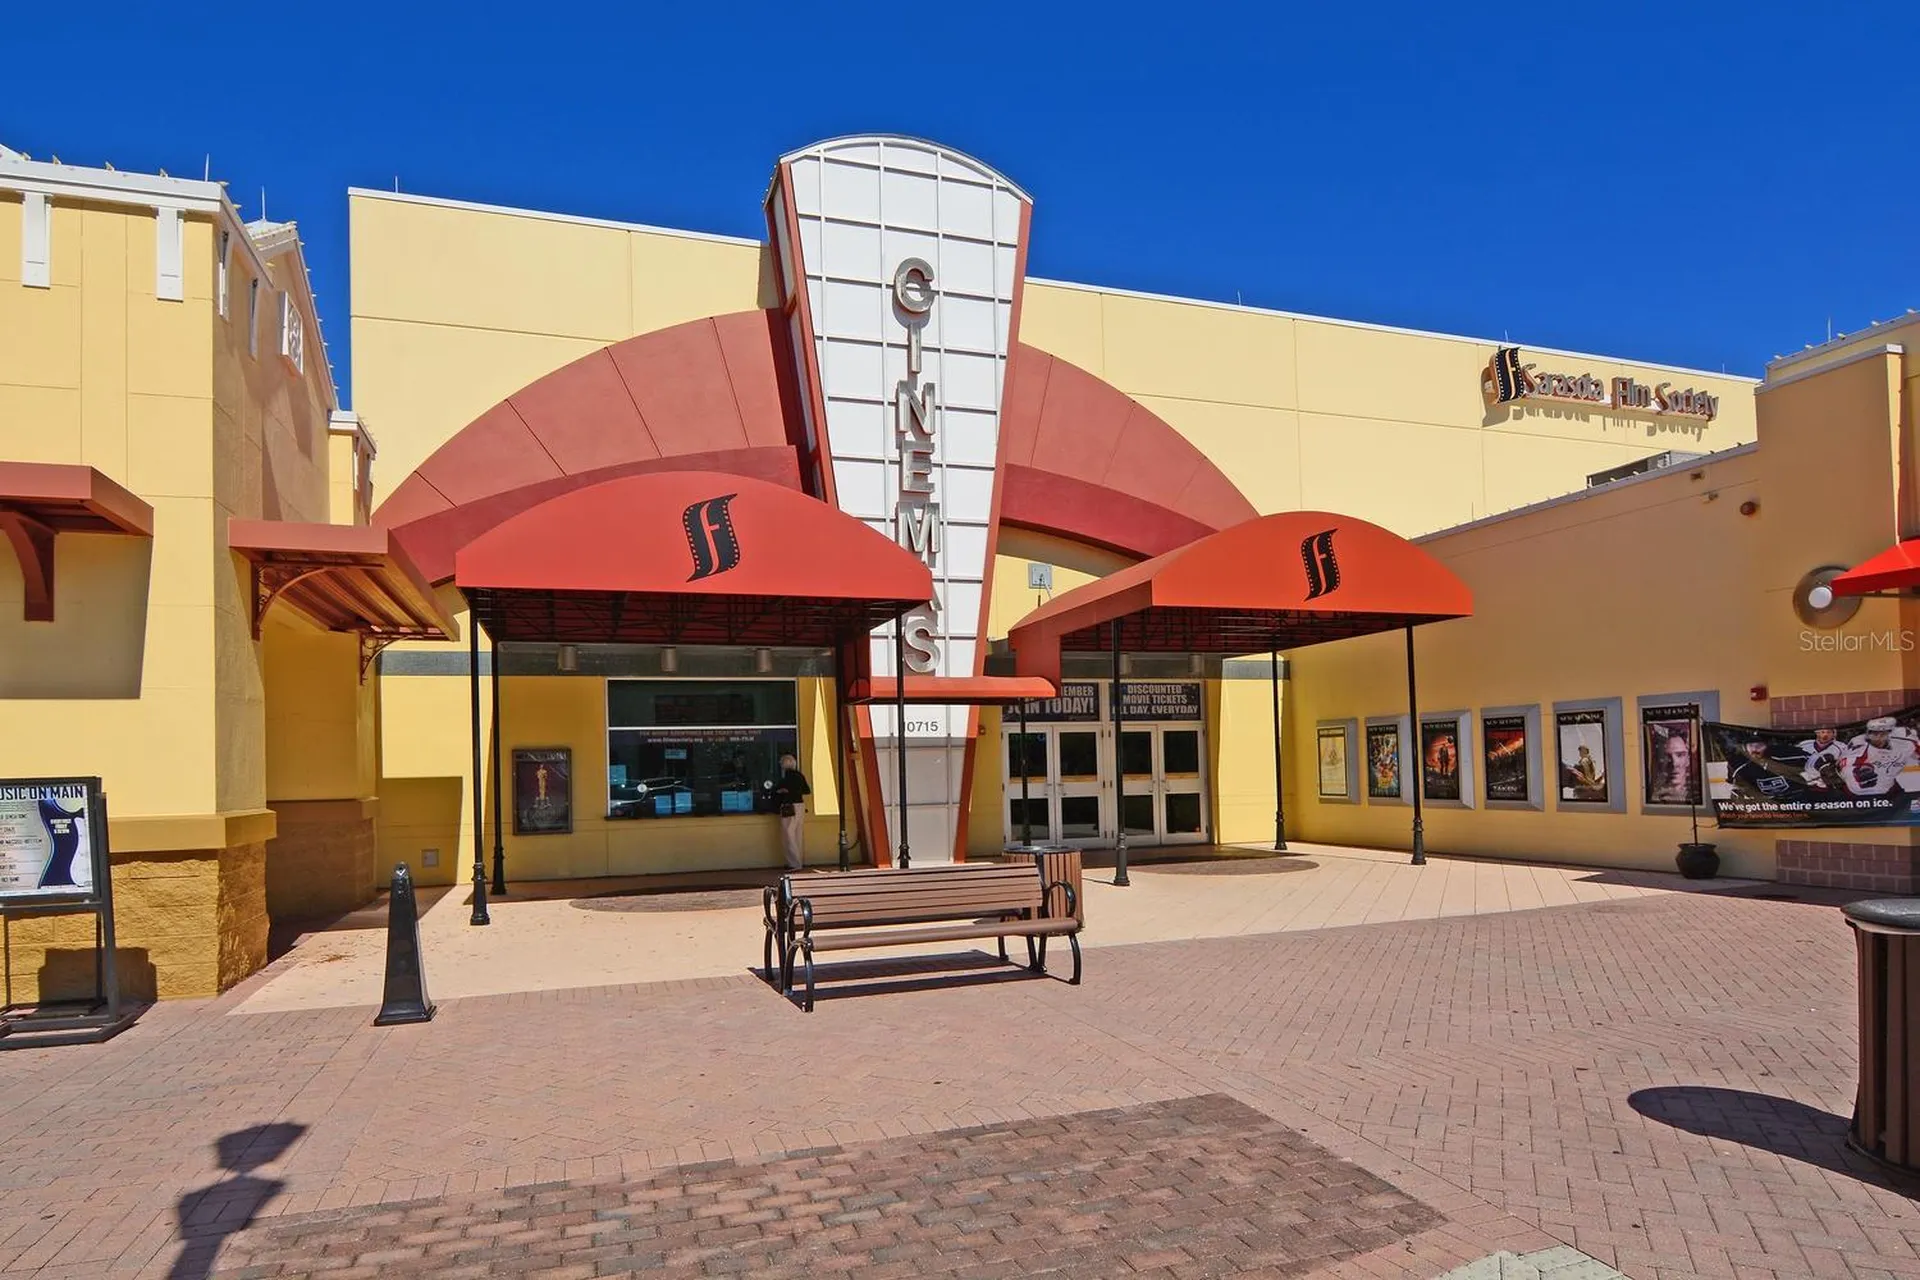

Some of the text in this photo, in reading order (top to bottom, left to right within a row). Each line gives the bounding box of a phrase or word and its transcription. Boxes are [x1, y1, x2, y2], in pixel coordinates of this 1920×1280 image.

[1522, 363, 1720, 422] Sarasota Film Society
[1061, 686, 1094, 697] EMBER
[1127, 684, 1182, 694] DISCOUNTED
[1122, 694, 1188, 704] MOVIE TICKETS
[1045, 697, 1094, 714] TODAY!
[1151, 704, 1199, 714] EVERYDAY
[904, 721, 939, 732] 0715
[29, 787, 47, 801] ON
[50, 785, 83, 799] MAIN
[1718, 798, 1893, 813] We've got the entire season on ice.
